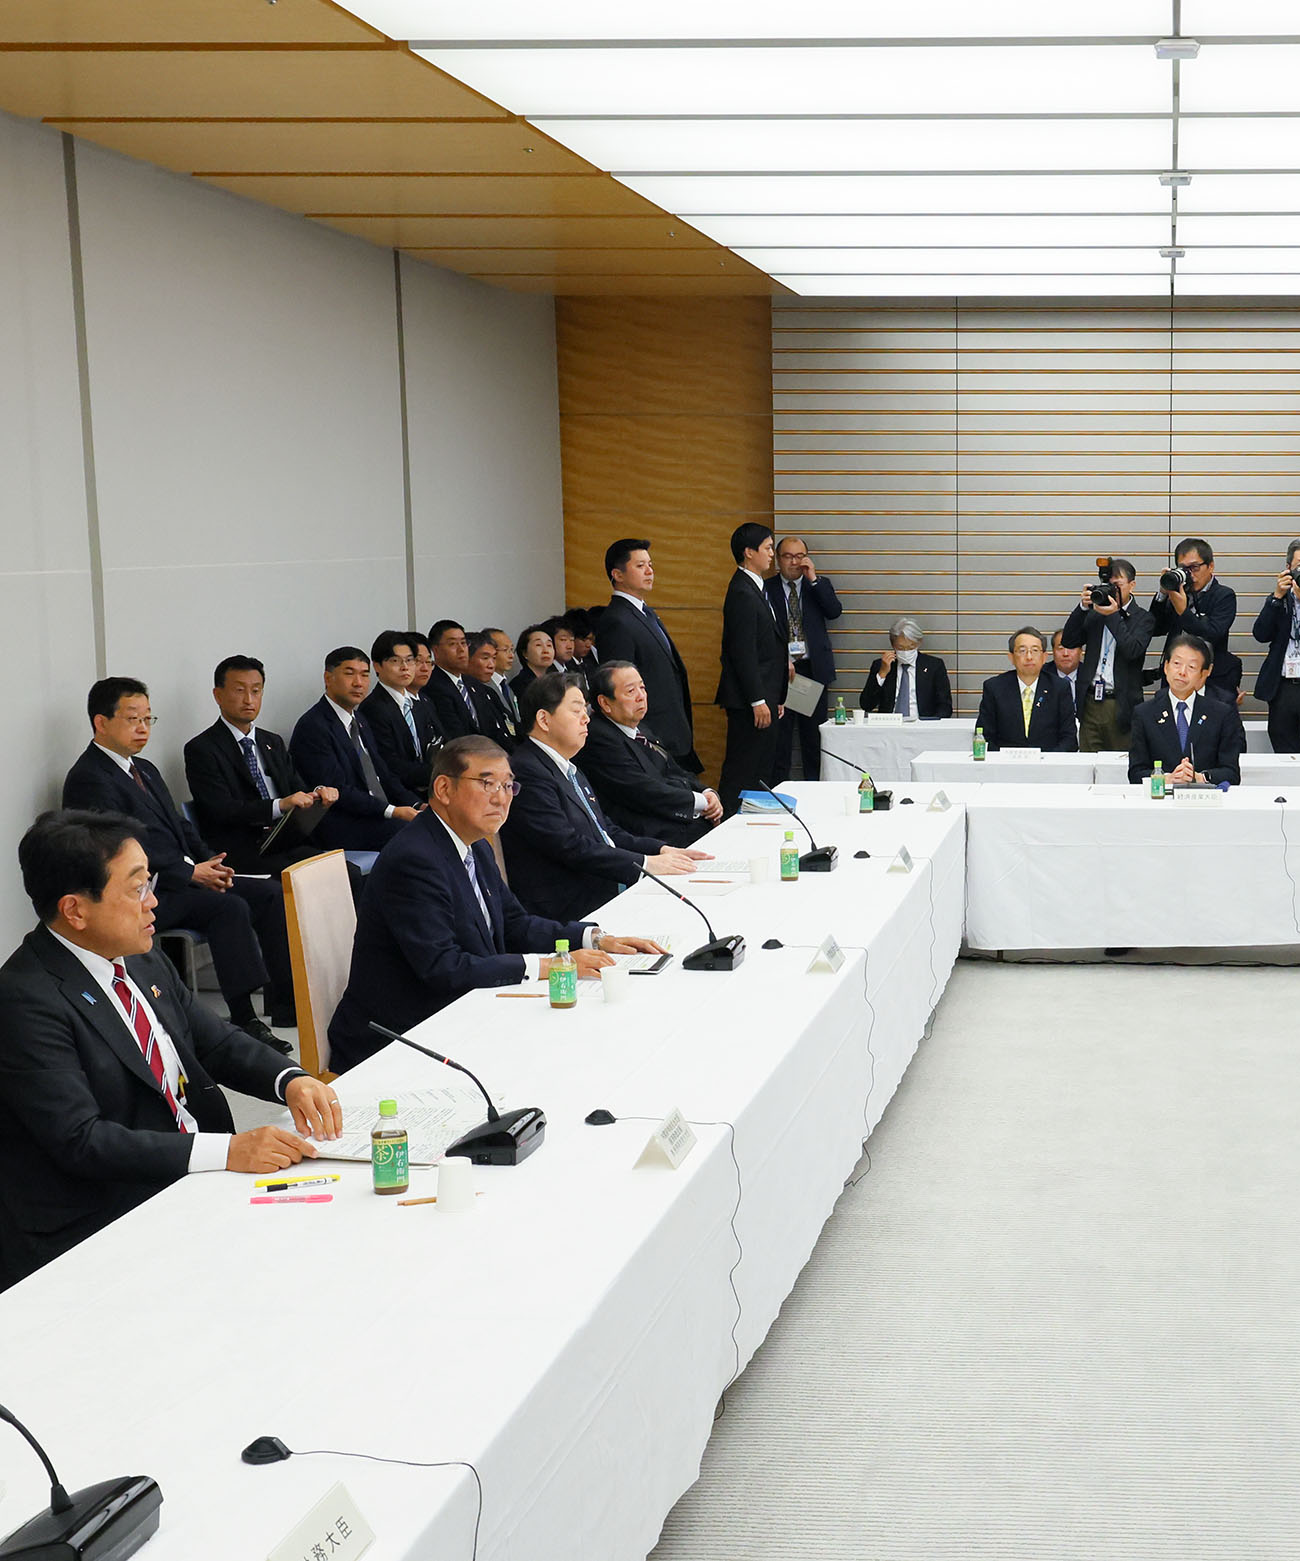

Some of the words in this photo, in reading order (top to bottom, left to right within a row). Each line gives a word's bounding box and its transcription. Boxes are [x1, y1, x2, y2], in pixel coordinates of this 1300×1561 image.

[375, 1145, 390, 1162] 茶
[303, 1515, 353, 1561] 務大臣
